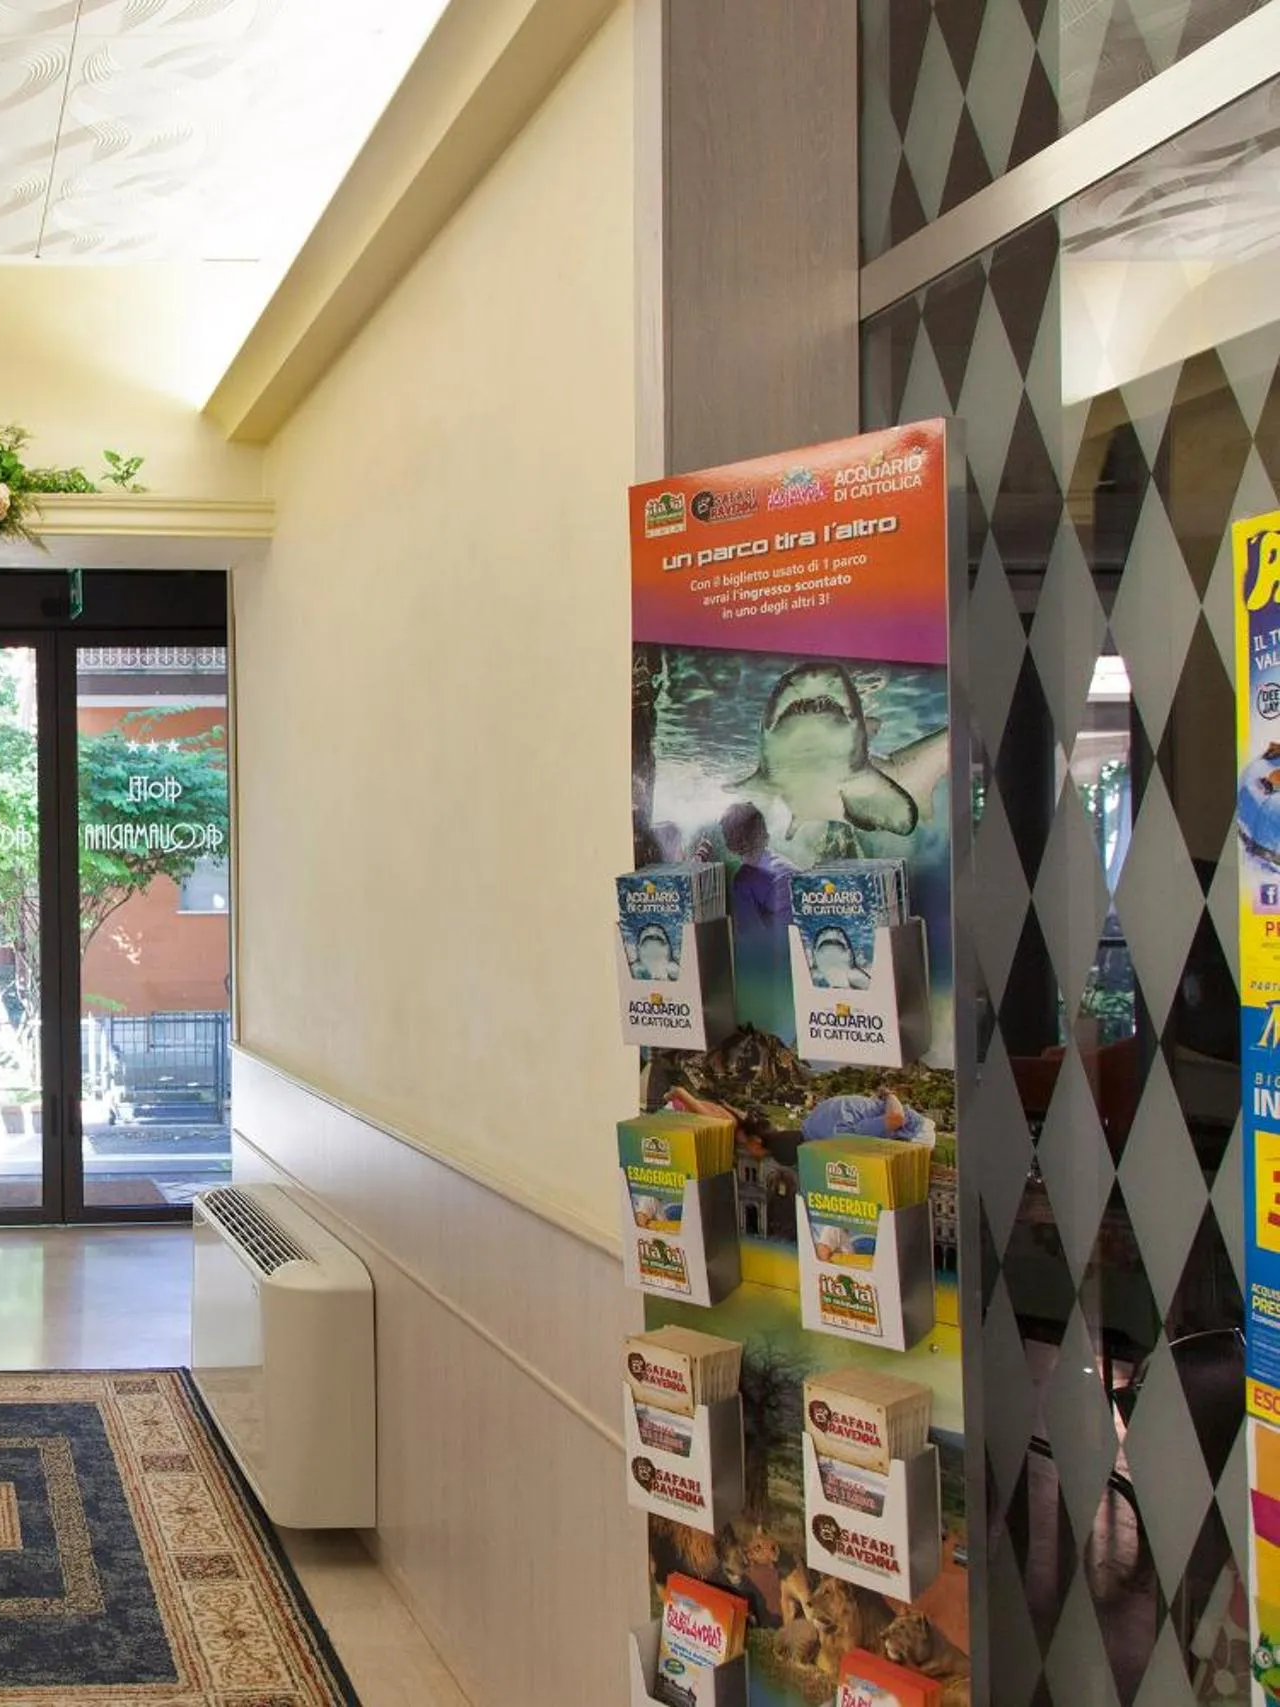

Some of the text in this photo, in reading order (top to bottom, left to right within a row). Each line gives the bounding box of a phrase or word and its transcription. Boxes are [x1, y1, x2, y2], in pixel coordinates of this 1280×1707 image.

[834, 453, 922, 487] ACQUARIO
[834, 489, 848, 502] DI
[851, 475, 922, 499] CATTOLICA
[662, 516, 898, 571] un parco tira l'altro
[690, 579, 711, 592] Con
[723, 570, 770, 588] biglietto
[773, 565, 804, 578] usato
[808, 562, 819, 573] di
[832, 554, 868, 570] parco
[703, 573, 852, 606] avrai l'ingresso scontato
[722, 607, 733, 619] in
[736, 605, 757, 618] uno
[760, 600, 788, 615] degli
[791, 595, 815, 609] altri
[1253, 634, 1267, 651] IL
[629, 1001, 690, 1018] ACQUARIO
[630, 1015, 692, 1029] DI CATTOLICA
[809, 1011, 883, 1031] ACQUARIO
[810, 1027, 885, 1044] DI CATTOLICA
[627, 1165, 686, 1188] ESAGERATO
[807, 1191, 878, 1220] ESAGERATO
[642, 1371, 689, 1394] RAVENNA
[645, 1363, 684, 1382] SAFARI
[830, 1411, 877, 1434] SAFARI
[825, 1423, 882, 1448] RAVENNA
[655, 1468, 701, 1494] SAFARI
[651, 1482, 705, 1508] RAVENNA
[839, 1528, 895, 1557] SAFARI
[836, 1541, 901, 1573] RAVENNA
